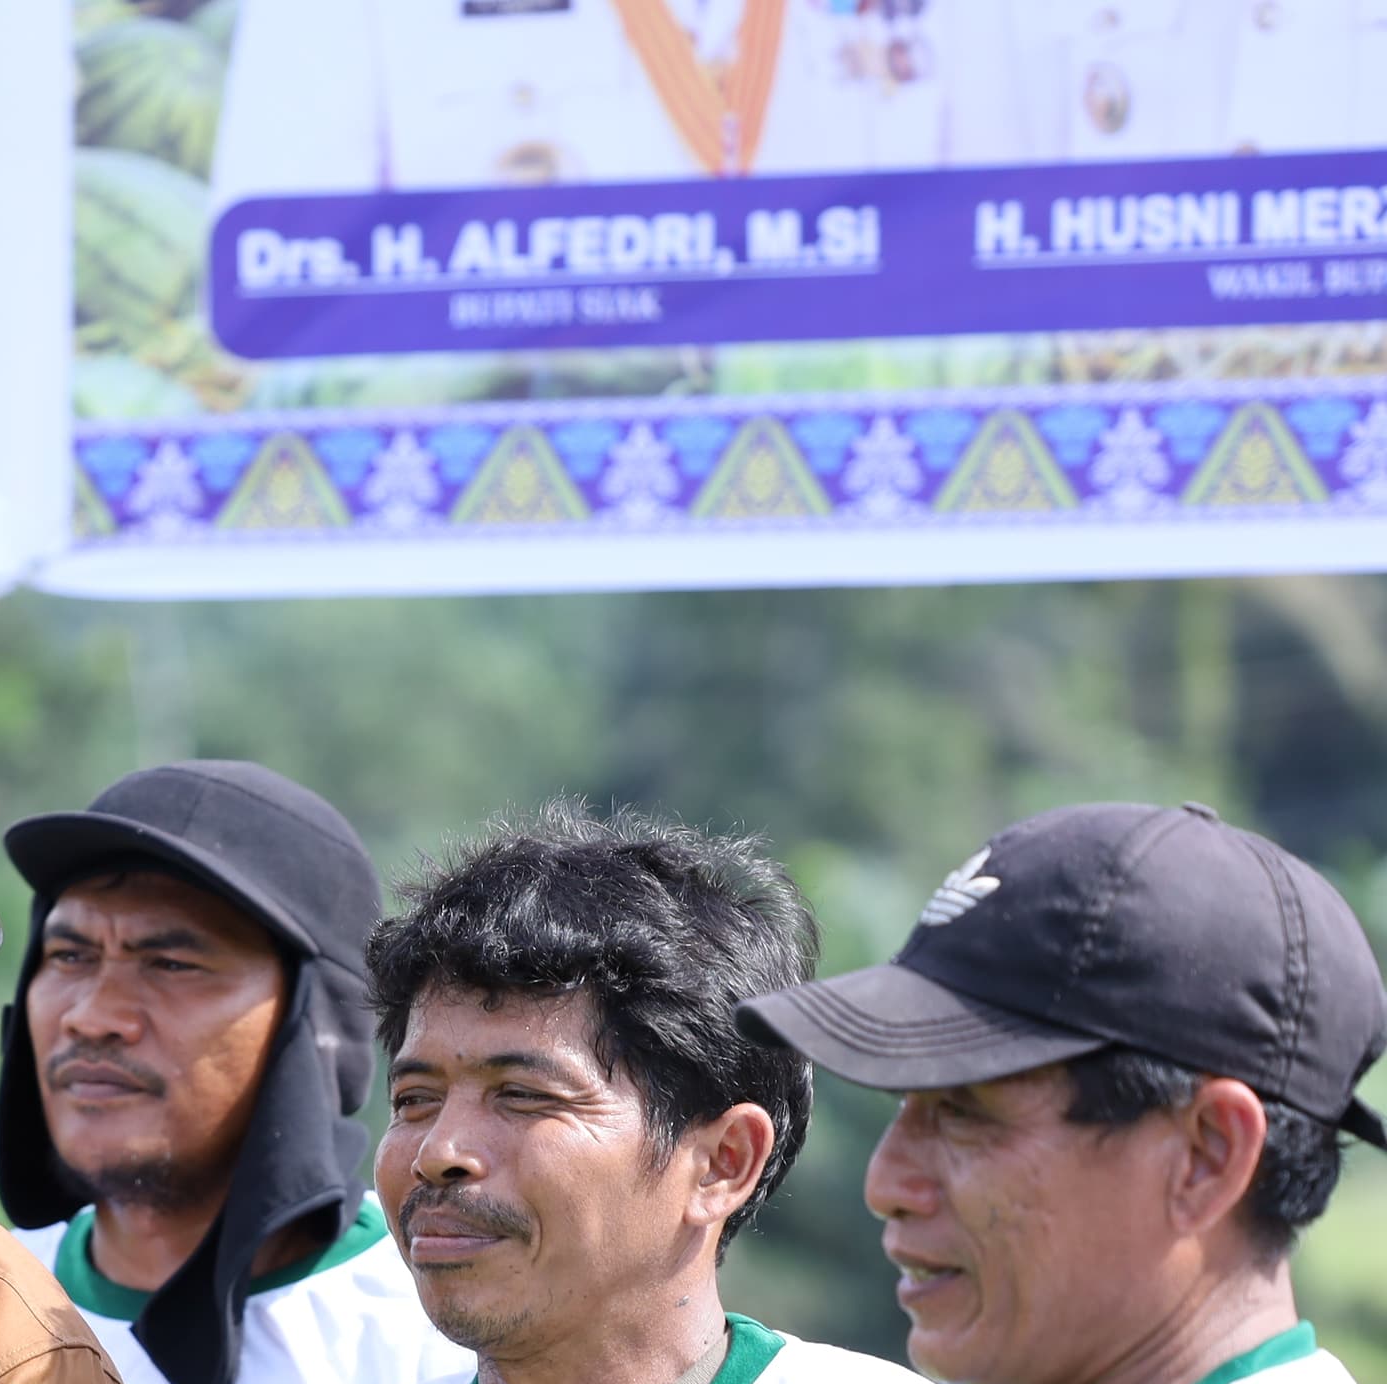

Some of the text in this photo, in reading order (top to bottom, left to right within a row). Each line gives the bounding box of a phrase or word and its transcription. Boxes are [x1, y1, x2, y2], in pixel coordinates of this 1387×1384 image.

[237, 205, 881, 288] Drs. H. ALFEDRI, M.Si
[975, 201, 1039, 260] H.
[1052, 190, 1240, 252] HUSNI
